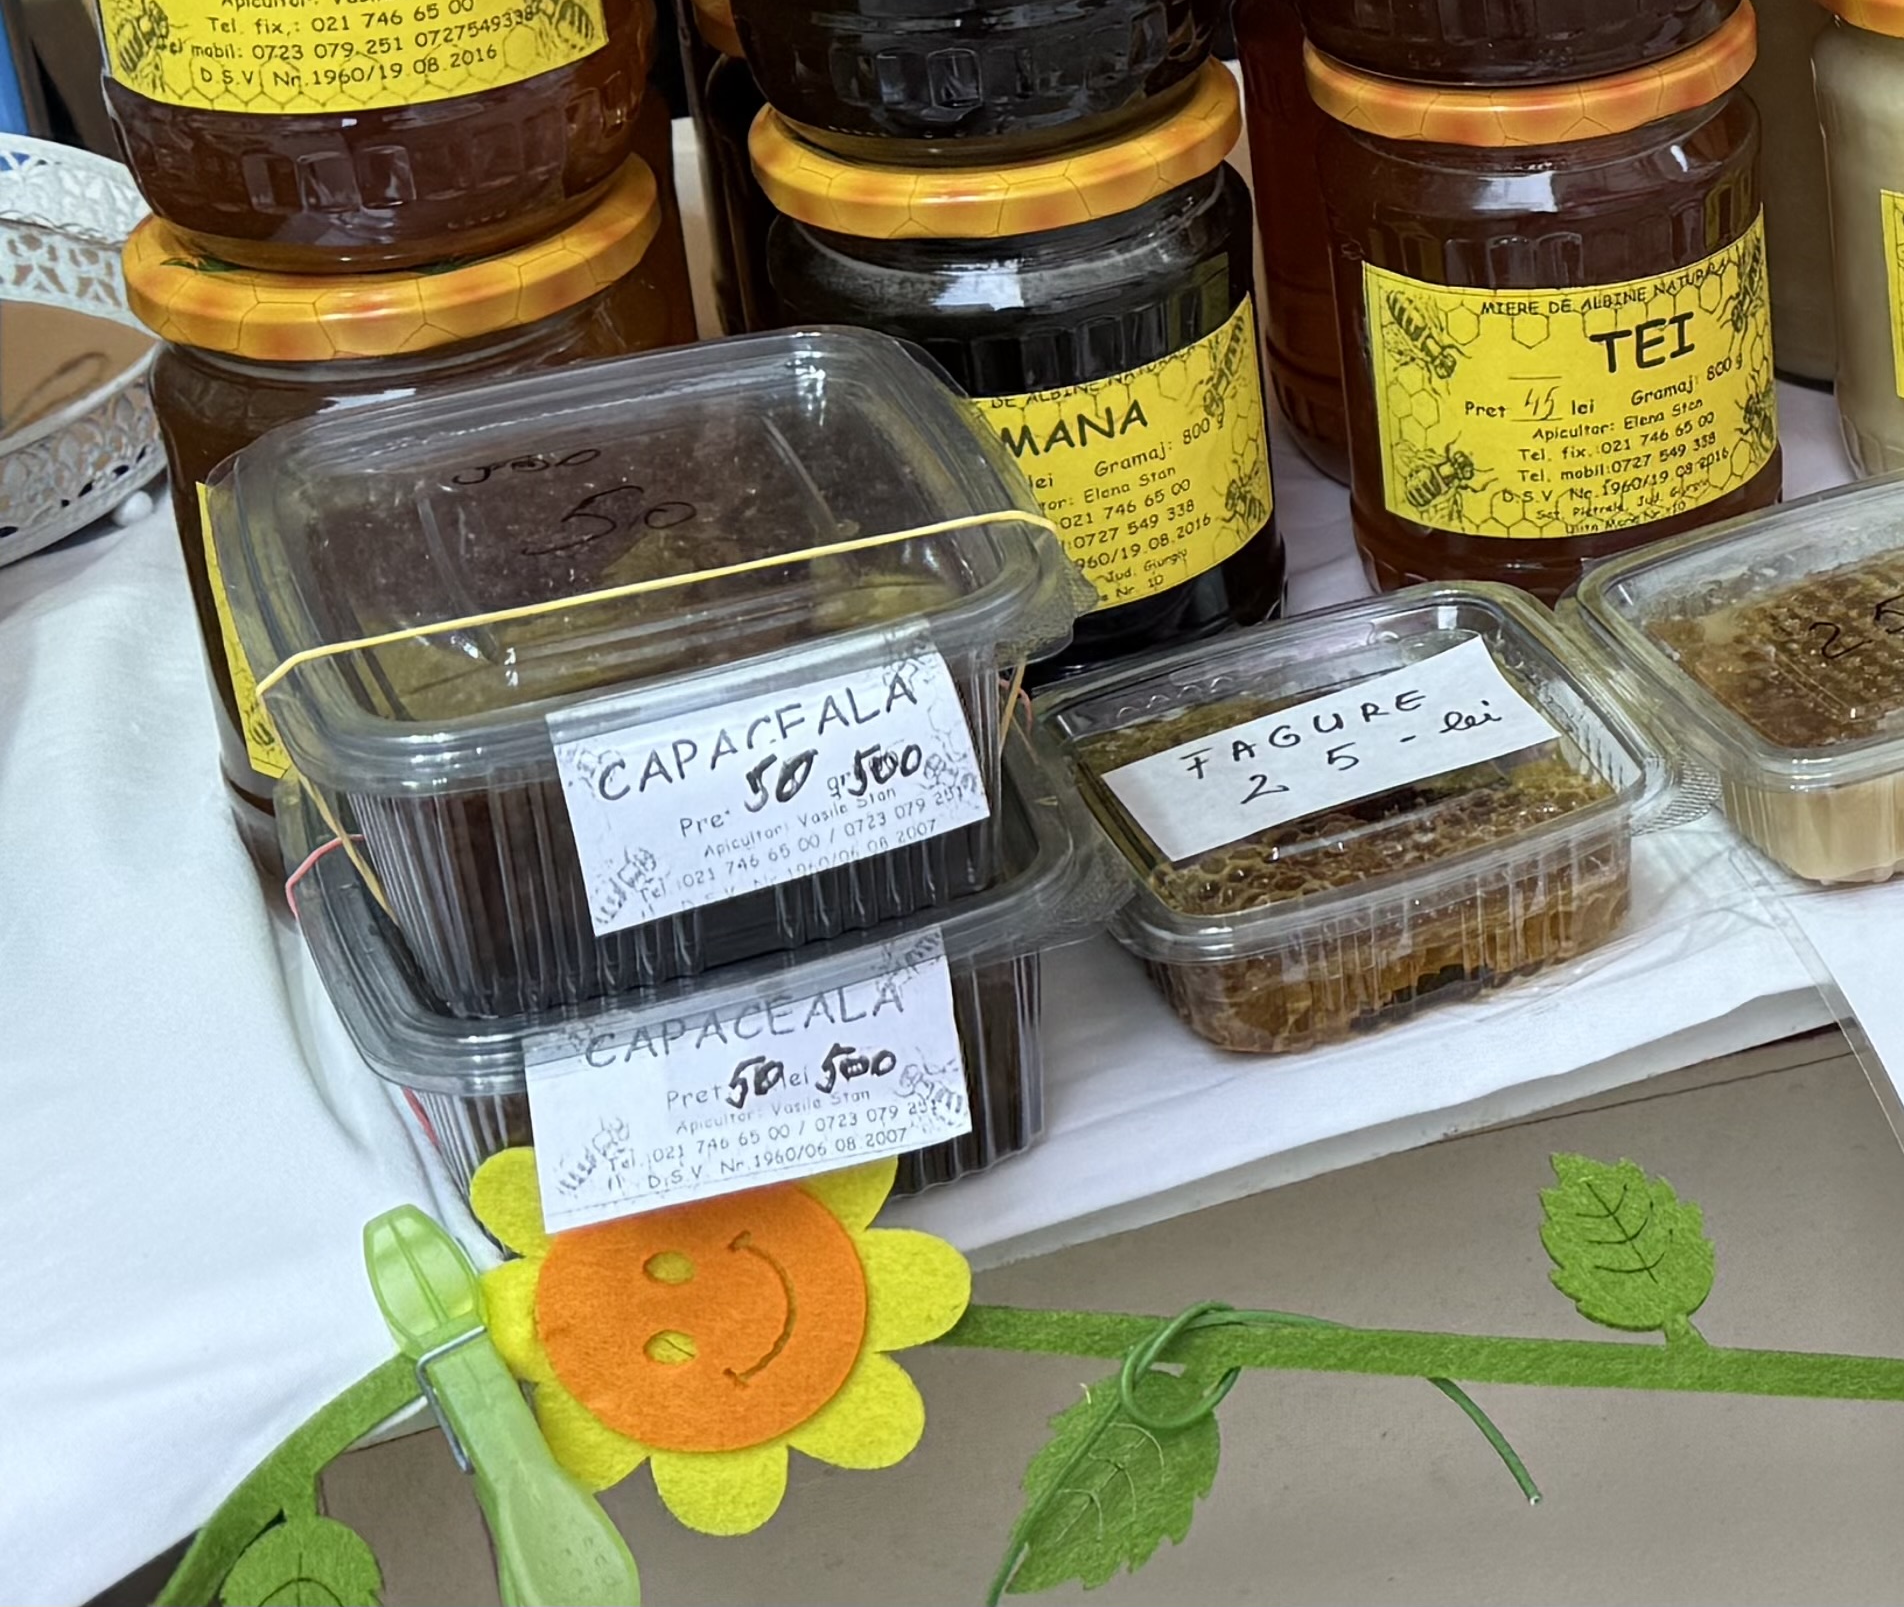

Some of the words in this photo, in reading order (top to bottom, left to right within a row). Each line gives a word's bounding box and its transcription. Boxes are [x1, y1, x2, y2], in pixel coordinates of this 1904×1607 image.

[311, 14, 351, 34] 021
[361, 6, 403, 29] 746
[414, 0, 441, 23] 65
[190, 36, 244, 59] mobil:
[251, 39, 304, 63] 0723
[1590, 313, 1695, 374] TEI
[1001, 399, 1148, 459] MANA
[1180, 689, 1428, 780] FAGURE
[1438, 699, 1504, 733] lei
[584, 986, 904, 1068] CAPACEALA
